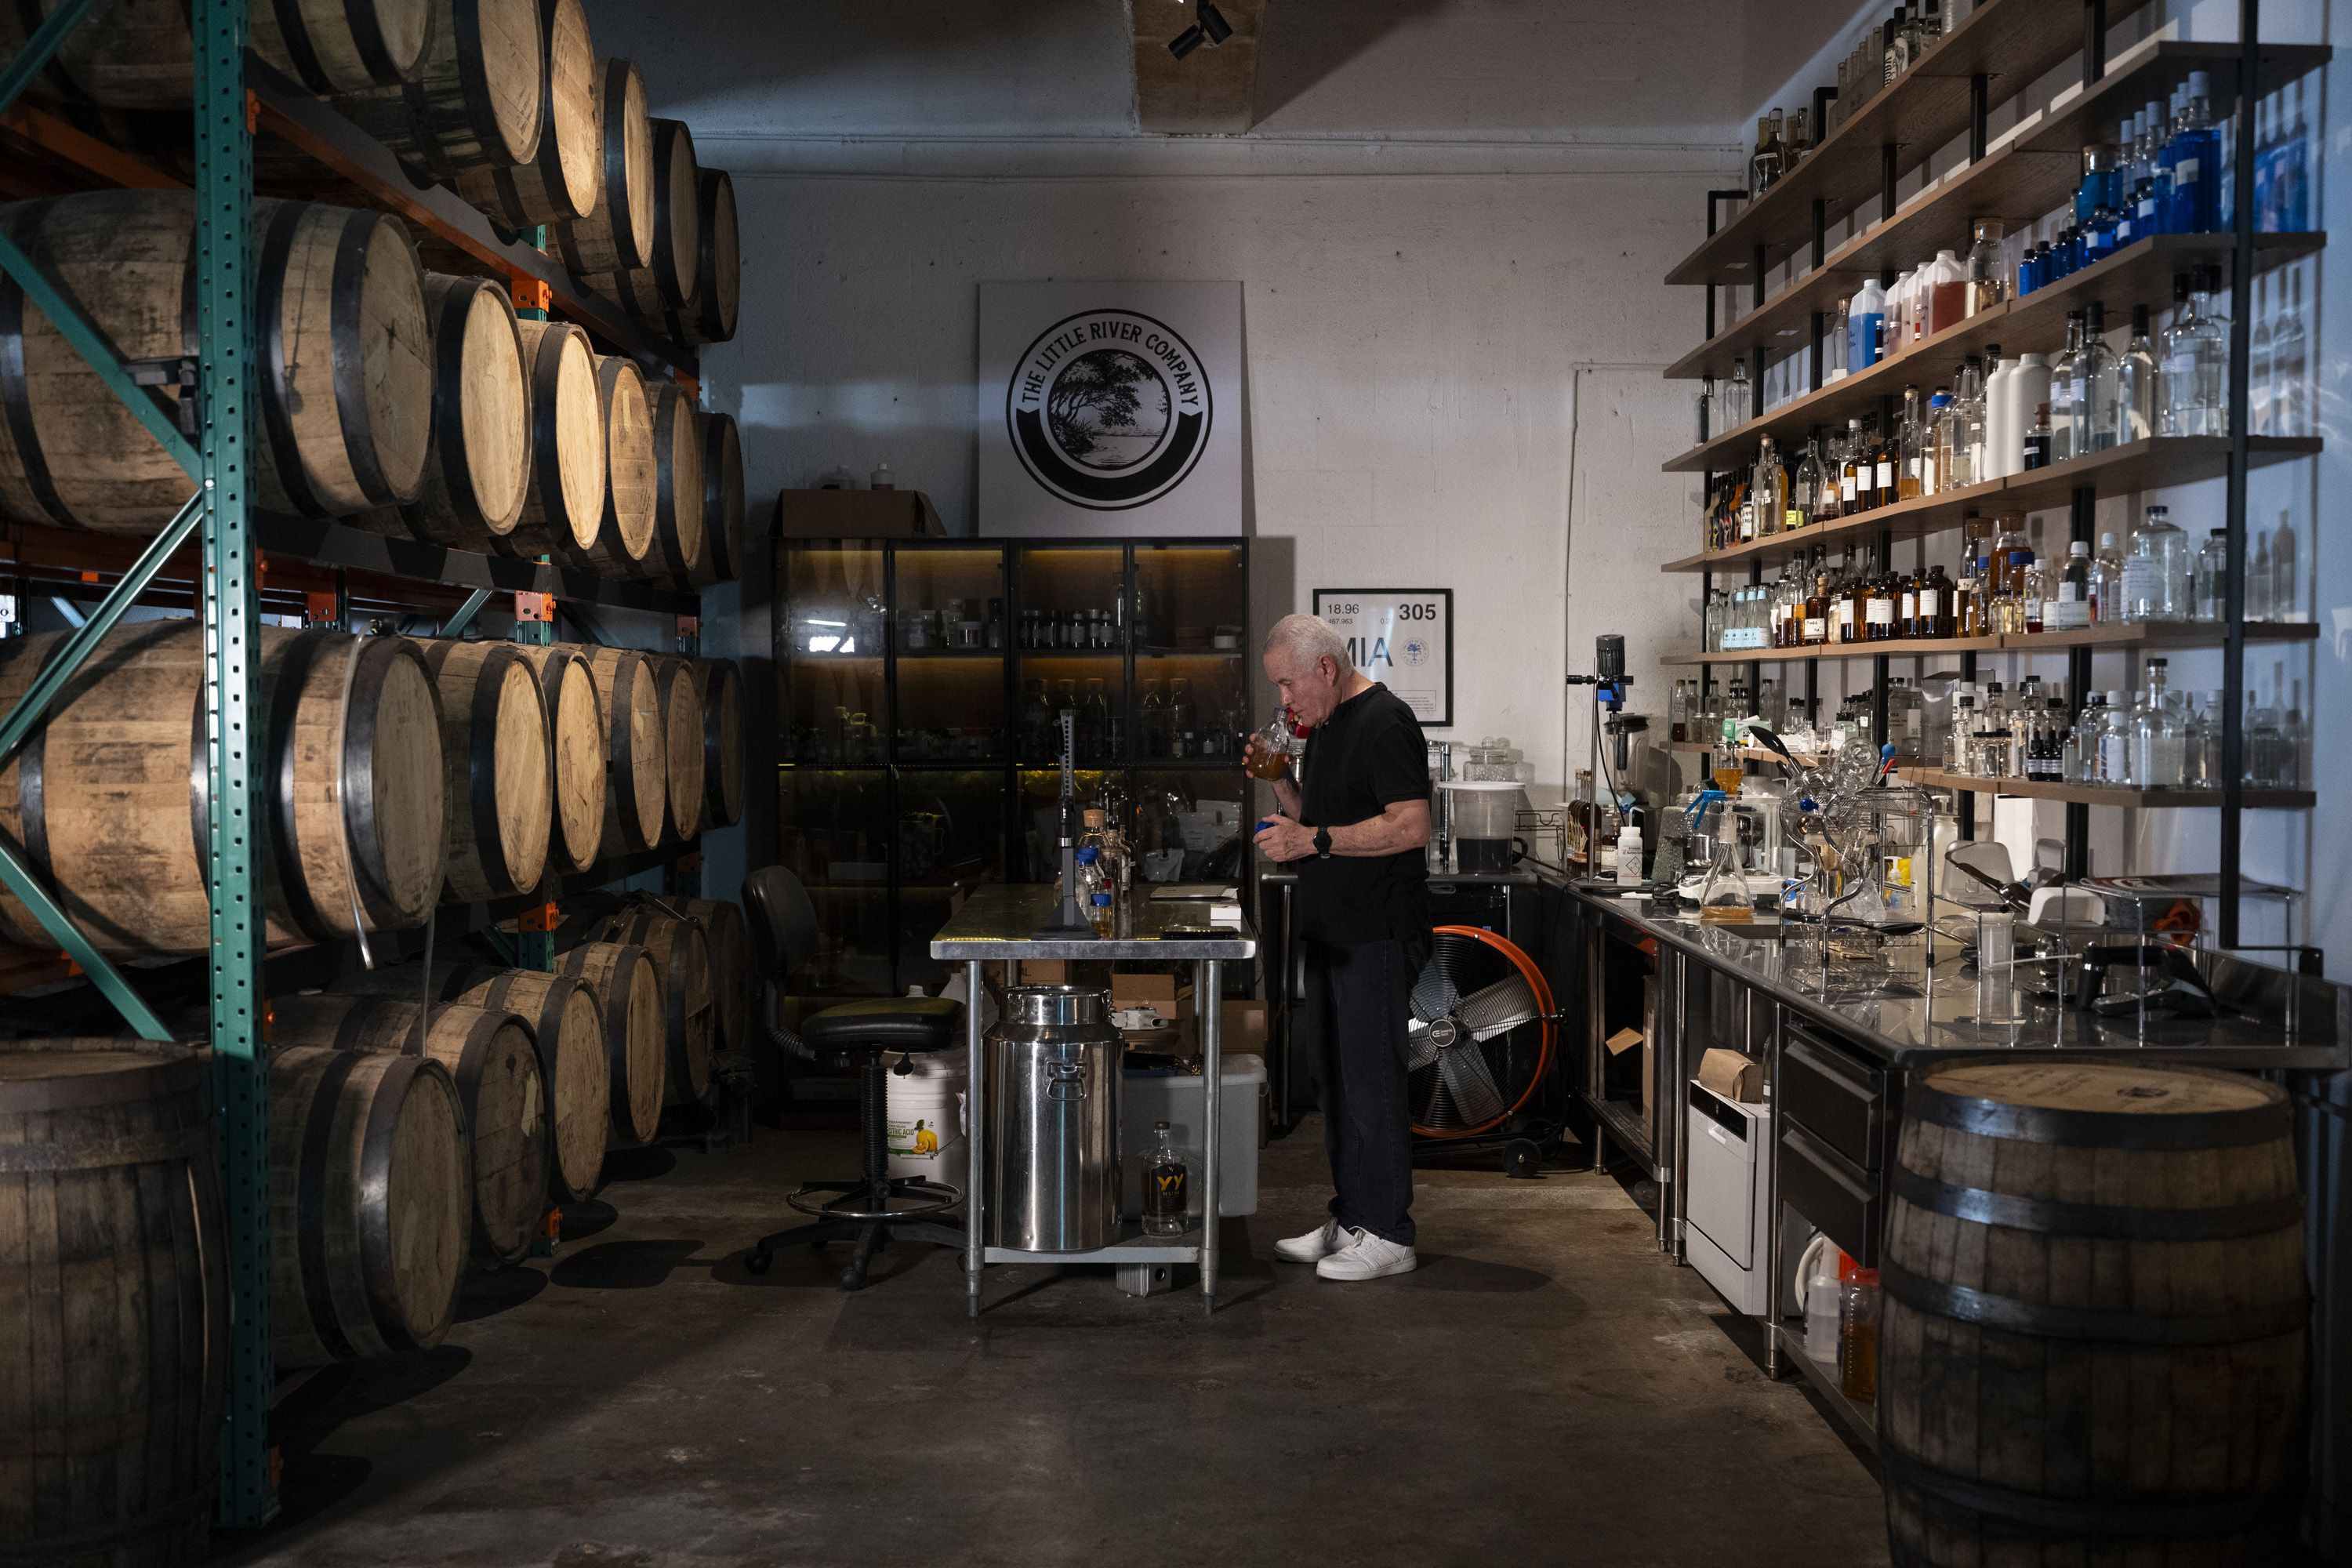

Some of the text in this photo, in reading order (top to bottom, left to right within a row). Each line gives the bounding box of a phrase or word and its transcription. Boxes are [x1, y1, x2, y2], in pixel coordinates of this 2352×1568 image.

[1022, 320, 1199, 407] THE LITTLE RIVER COMPANY
[1327, 604, 1359, 615] 18.96
[1399, 604, 1436, 620] 305
[1156, 1173, 1185, 1192] YY
